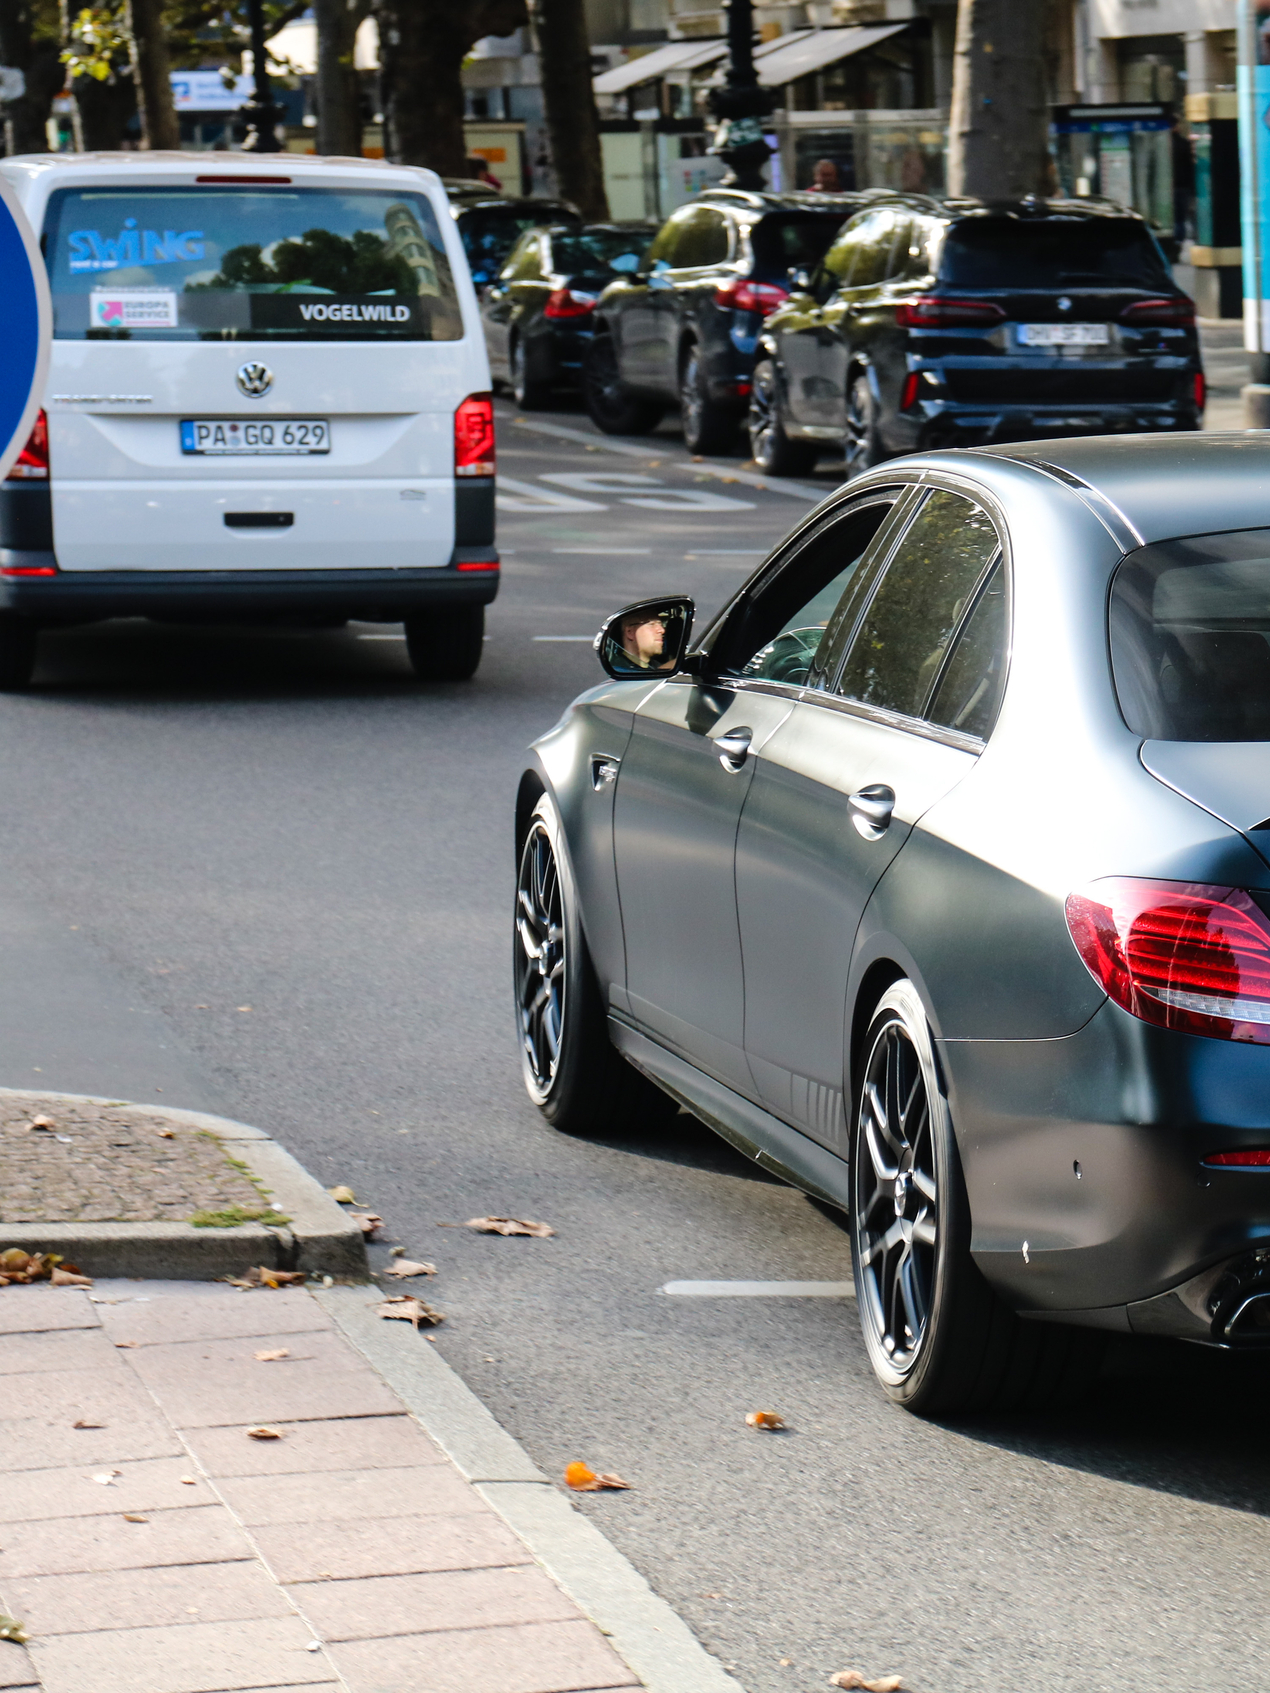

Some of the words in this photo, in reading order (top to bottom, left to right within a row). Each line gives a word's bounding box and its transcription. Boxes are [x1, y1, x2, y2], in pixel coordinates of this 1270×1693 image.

[125, 301, 170, 309] EUROPA
[125, 310, 170, 319] SERVICE
[299, 303, 411, 321] VOGELWILD
[197, 425, 227, 445] PA
[244, 425, 275, 445] GQ
[282, 424, 326, 445] 629
